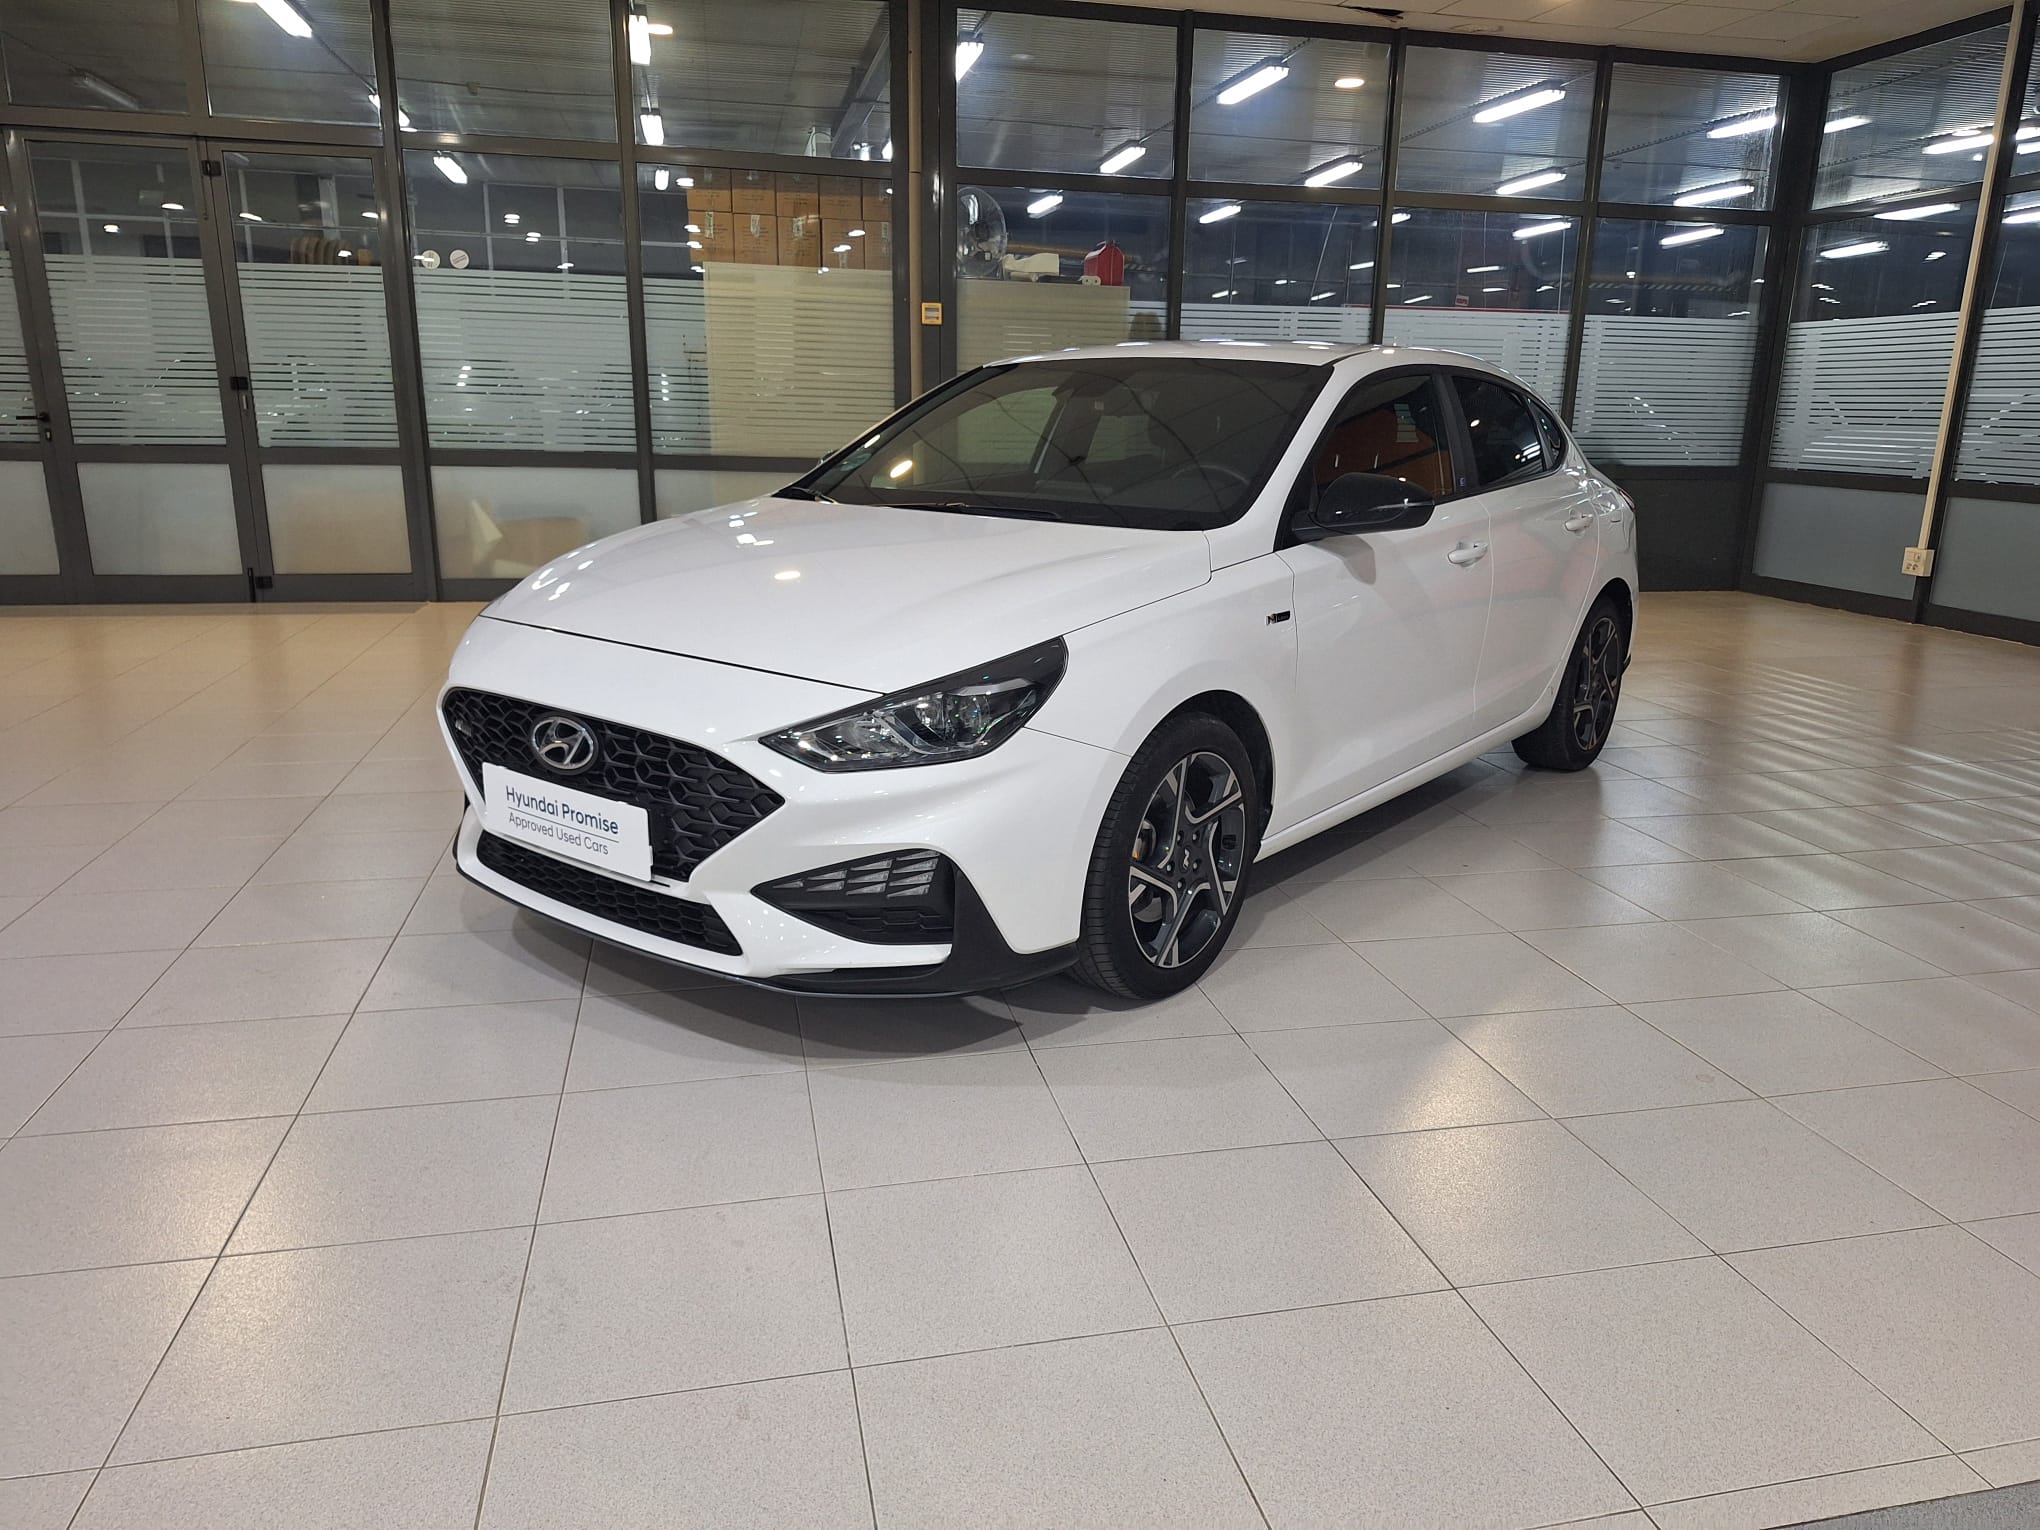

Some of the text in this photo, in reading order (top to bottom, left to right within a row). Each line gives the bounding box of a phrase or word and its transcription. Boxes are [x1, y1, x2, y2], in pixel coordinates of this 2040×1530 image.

[506, 785, 619, 835] Hyundai Promise
[509, 812, 609, 855] Approved Used Cars
